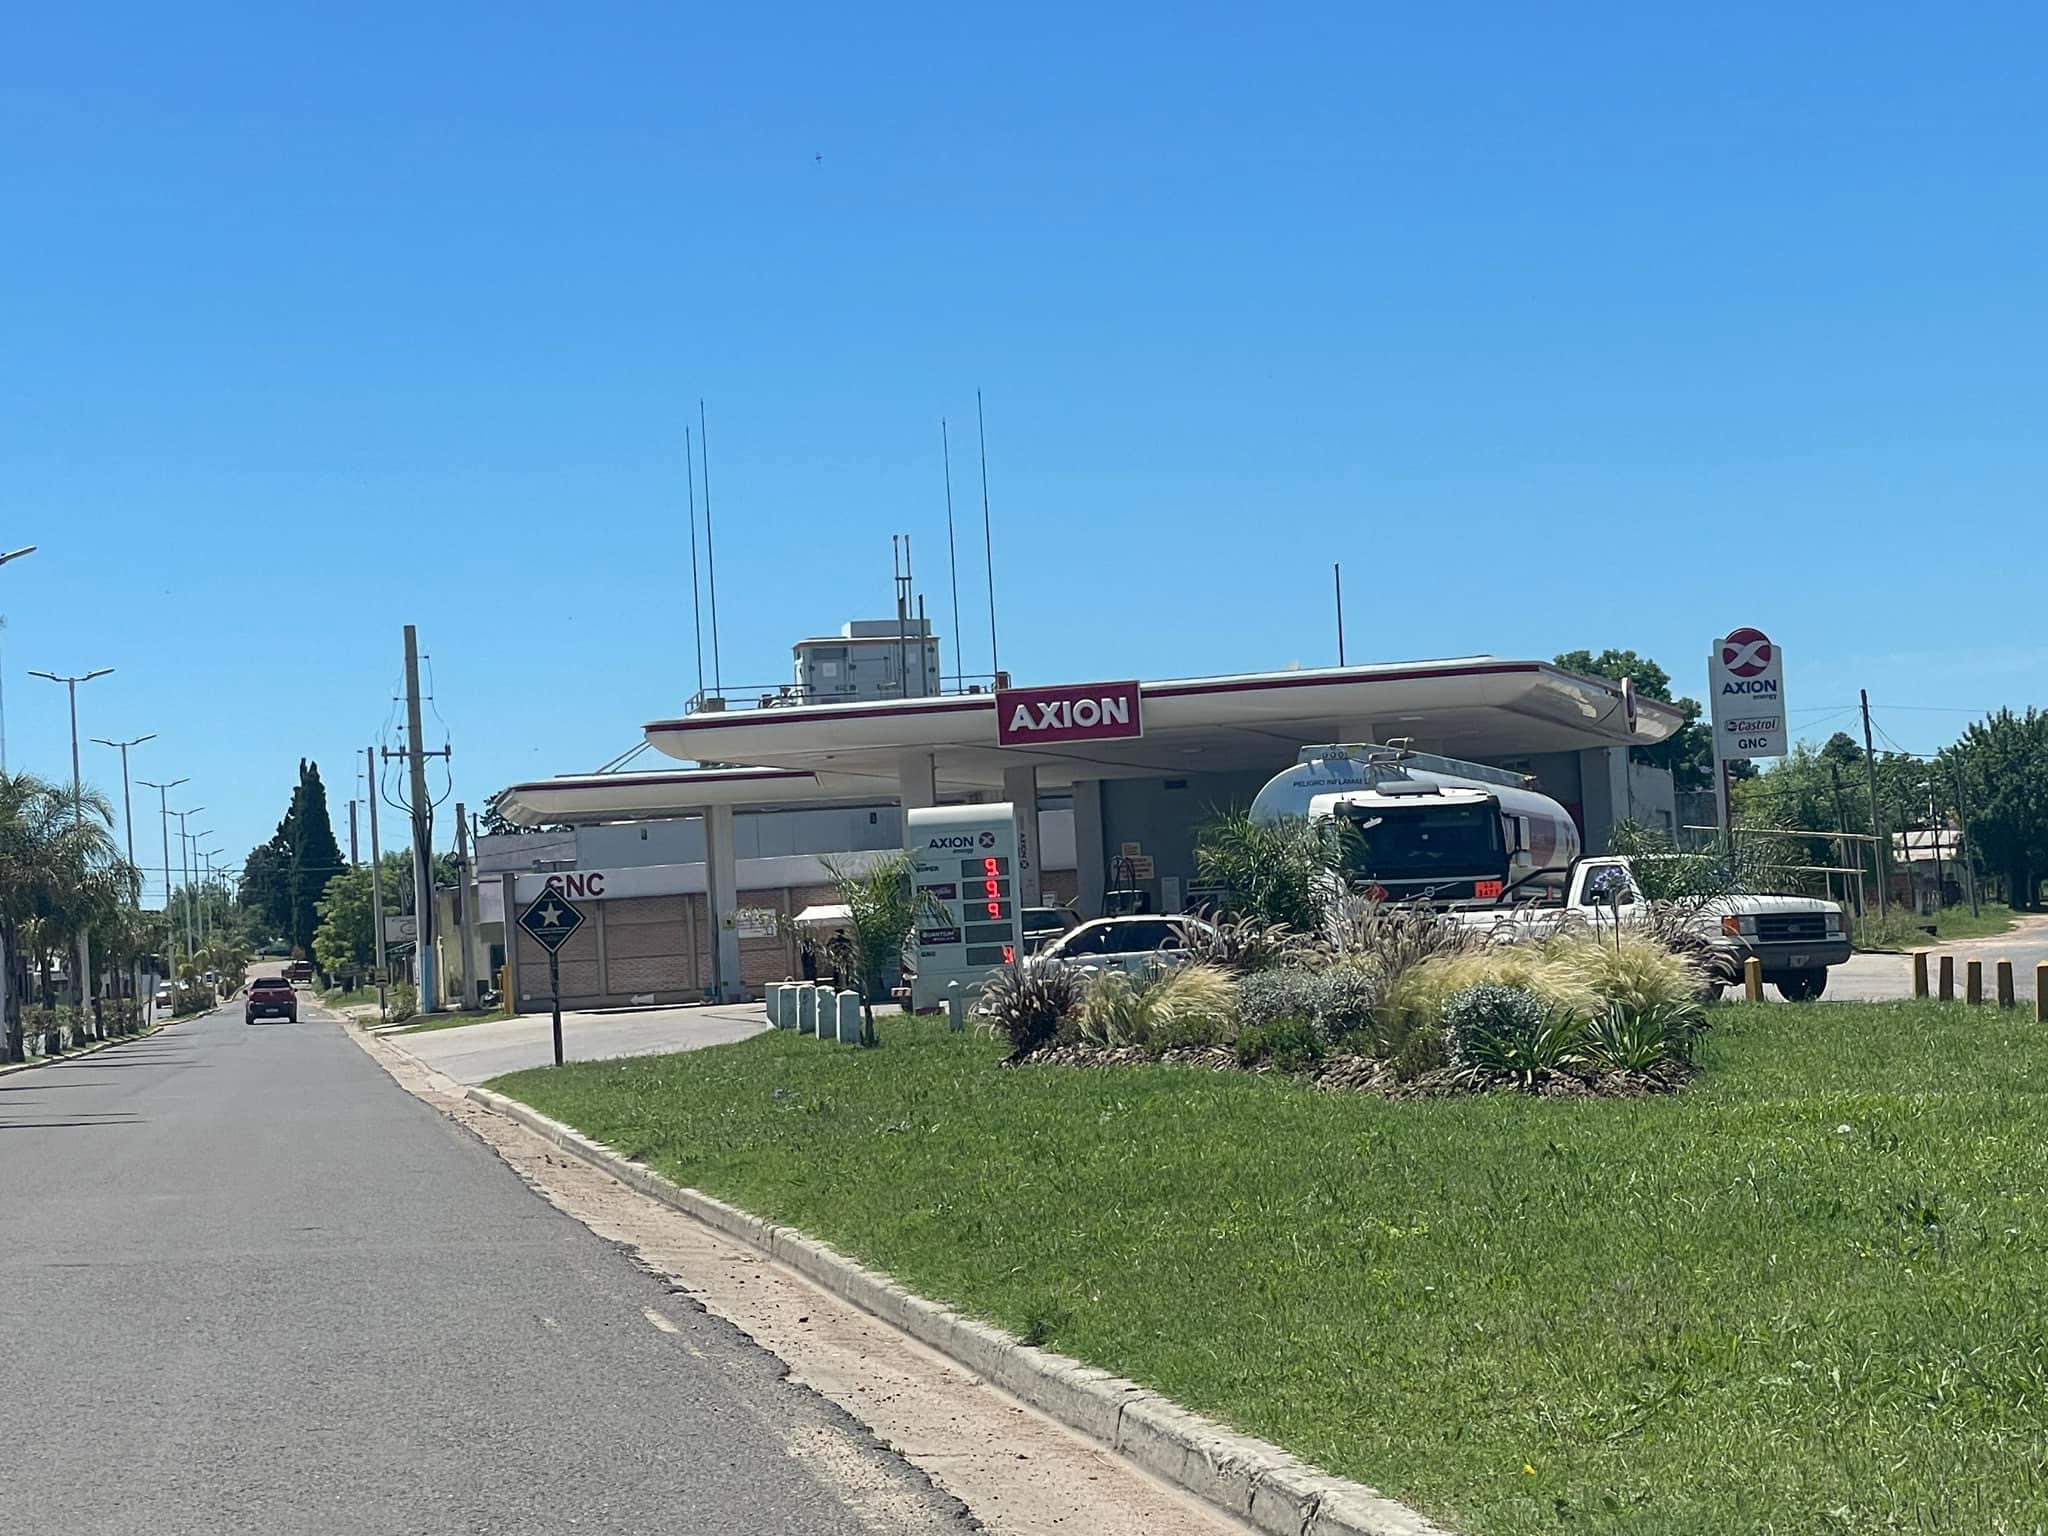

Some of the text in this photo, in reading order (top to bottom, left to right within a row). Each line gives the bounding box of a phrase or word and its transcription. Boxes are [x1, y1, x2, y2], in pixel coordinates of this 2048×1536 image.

[1722, 680, 1777, 695] AXION
[1008, 697, 1129, 731] AXION
[1738, 719, 1776, 732] Castrol
[1738, 738, 1767, 749] GNC
[929, 836, 974, 848] AXION
[545, 873, 604, 897] GNC
